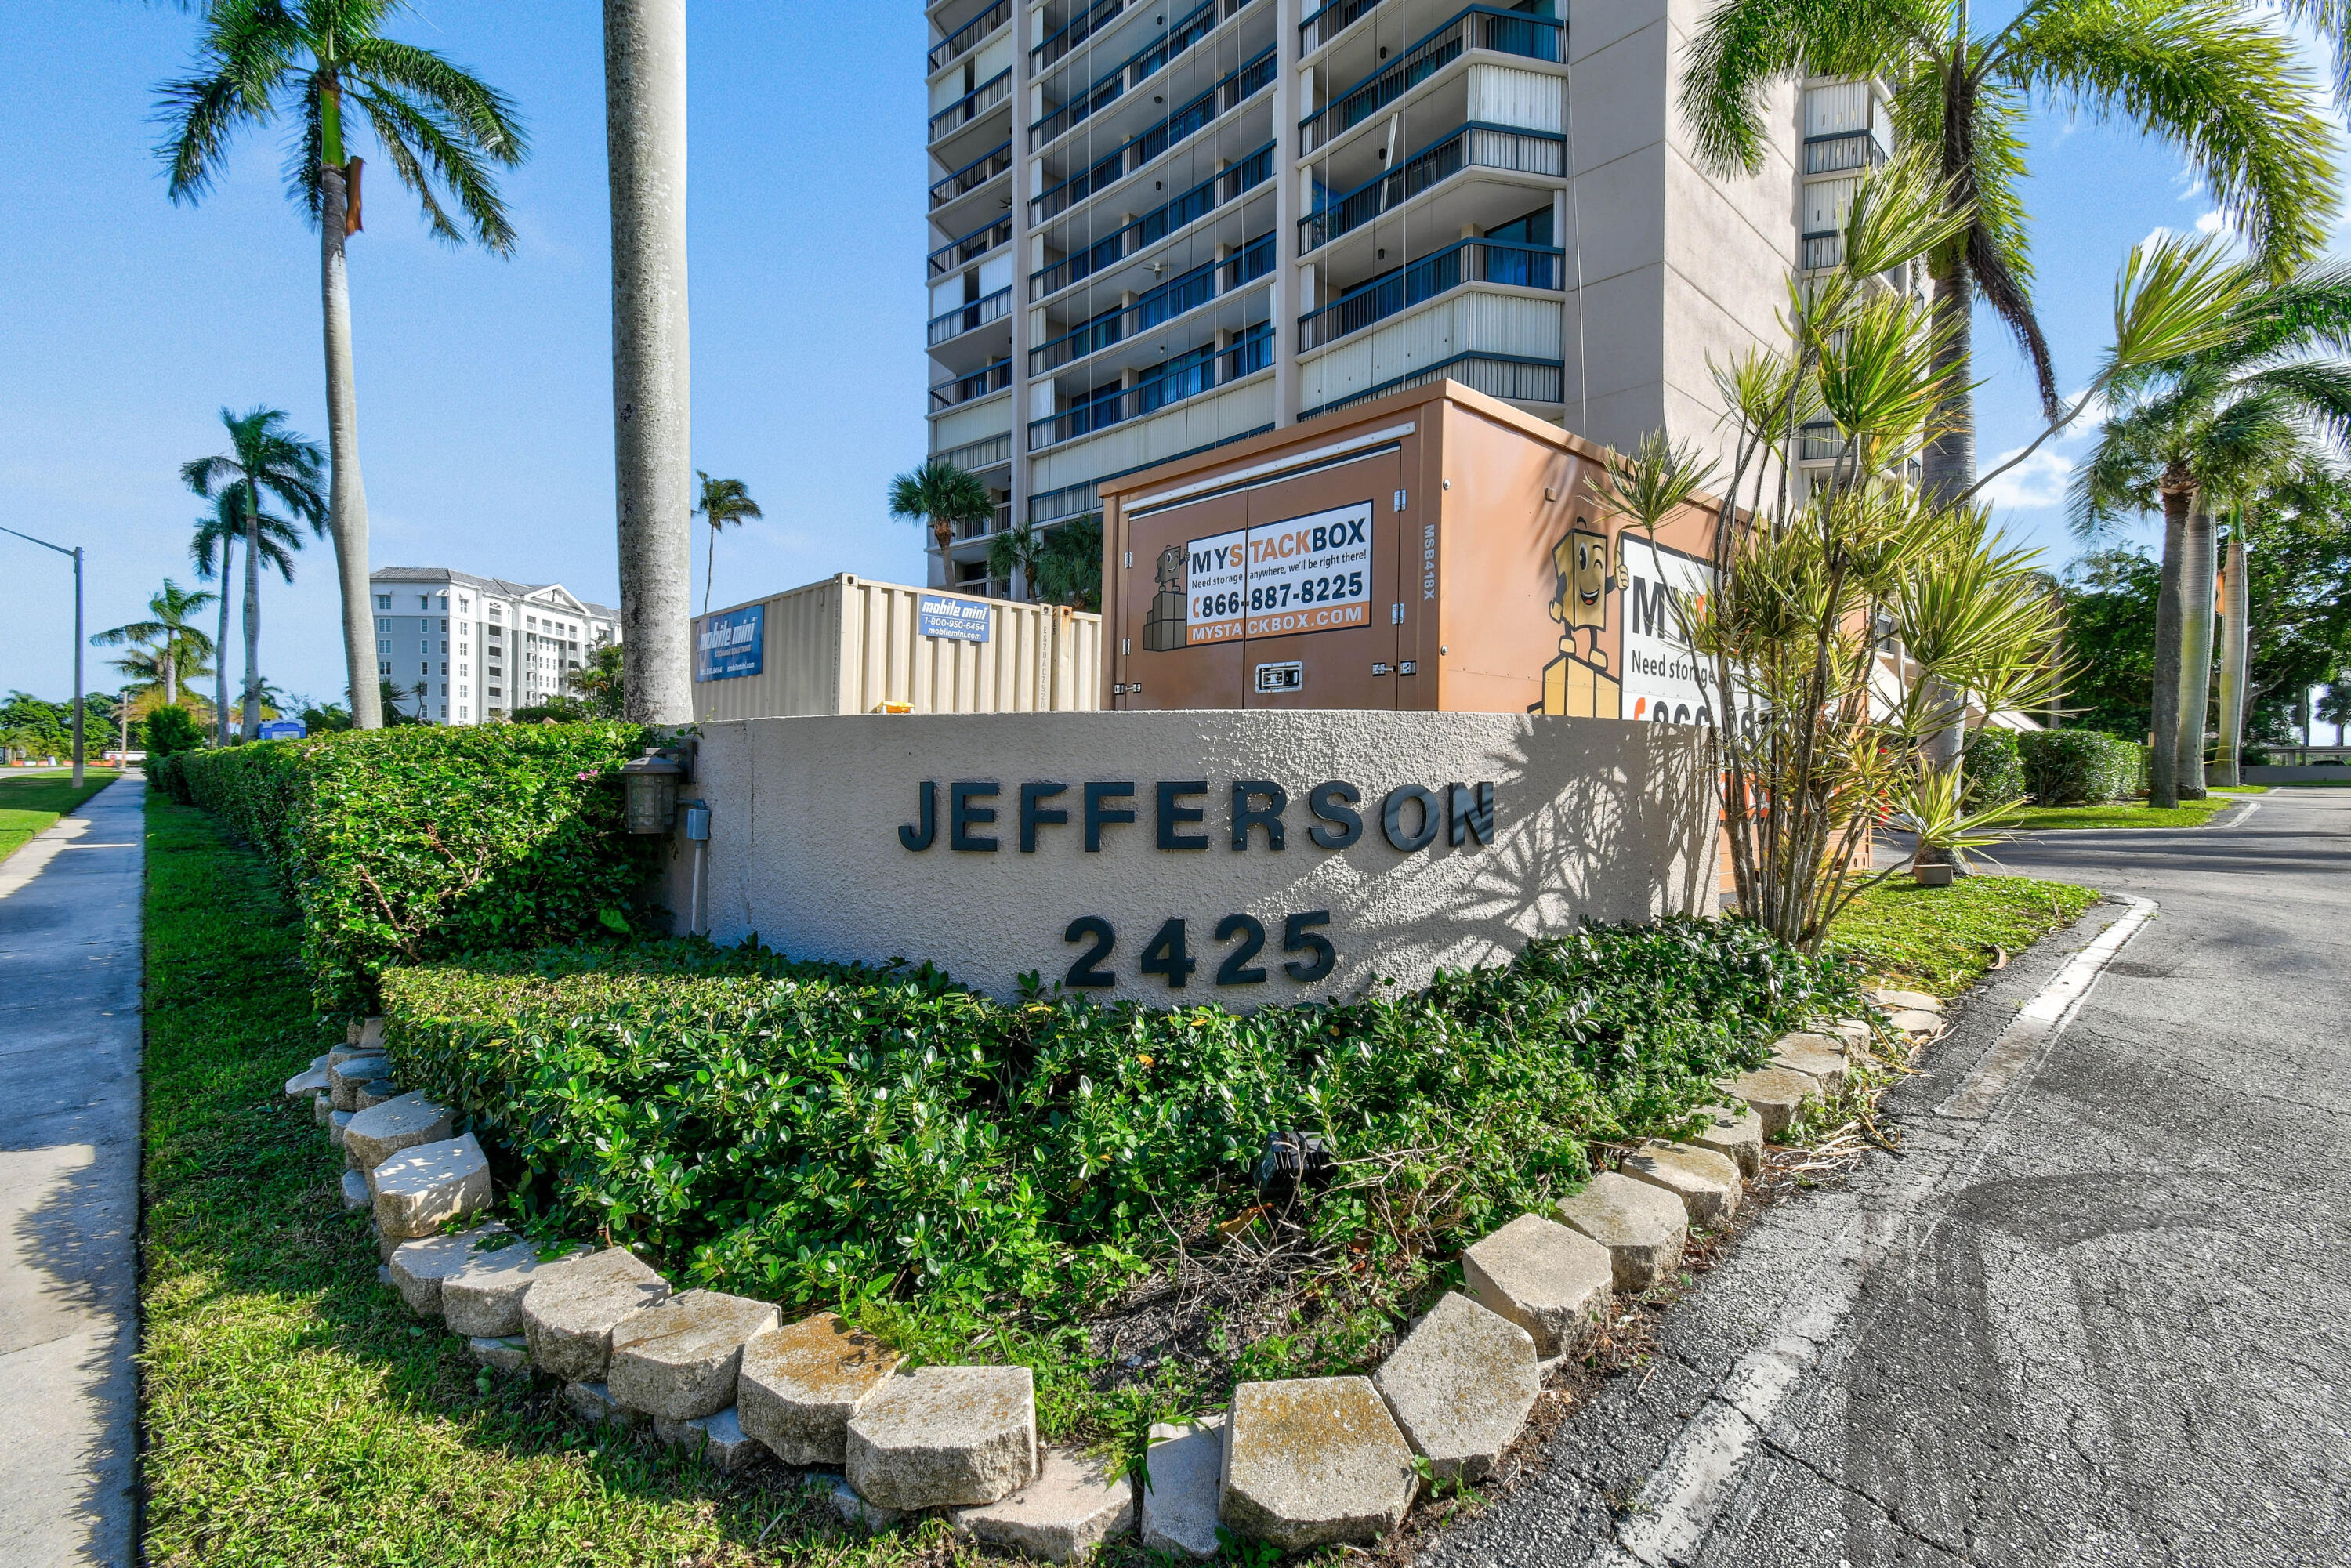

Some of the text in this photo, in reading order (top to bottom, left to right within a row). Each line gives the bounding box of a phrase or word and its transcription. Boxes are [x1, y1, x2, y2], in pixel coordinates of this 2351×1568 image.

[1191, 549, 1367, 589] Need storage anywhere, we'll be right there!
[1423, 523, 1435, 601] MSB418X
[922, 599, 987, 620] mobile mini
[1201, 571, 1362, 618] 866-887-8225
[700, 617, 755, 651] mobile mini
[924, 617, 985, 632] 1-800-950-6464
[928, 628, 981, 639] mobilemini.com
[1191, 607, 1363, 641] MYSTACKBOX.COM
[1632, 650, 1665, 677] Need
[898, 780, 1494, 853] JEFFERSON
[1064, 910, 1337, 988] 2425
